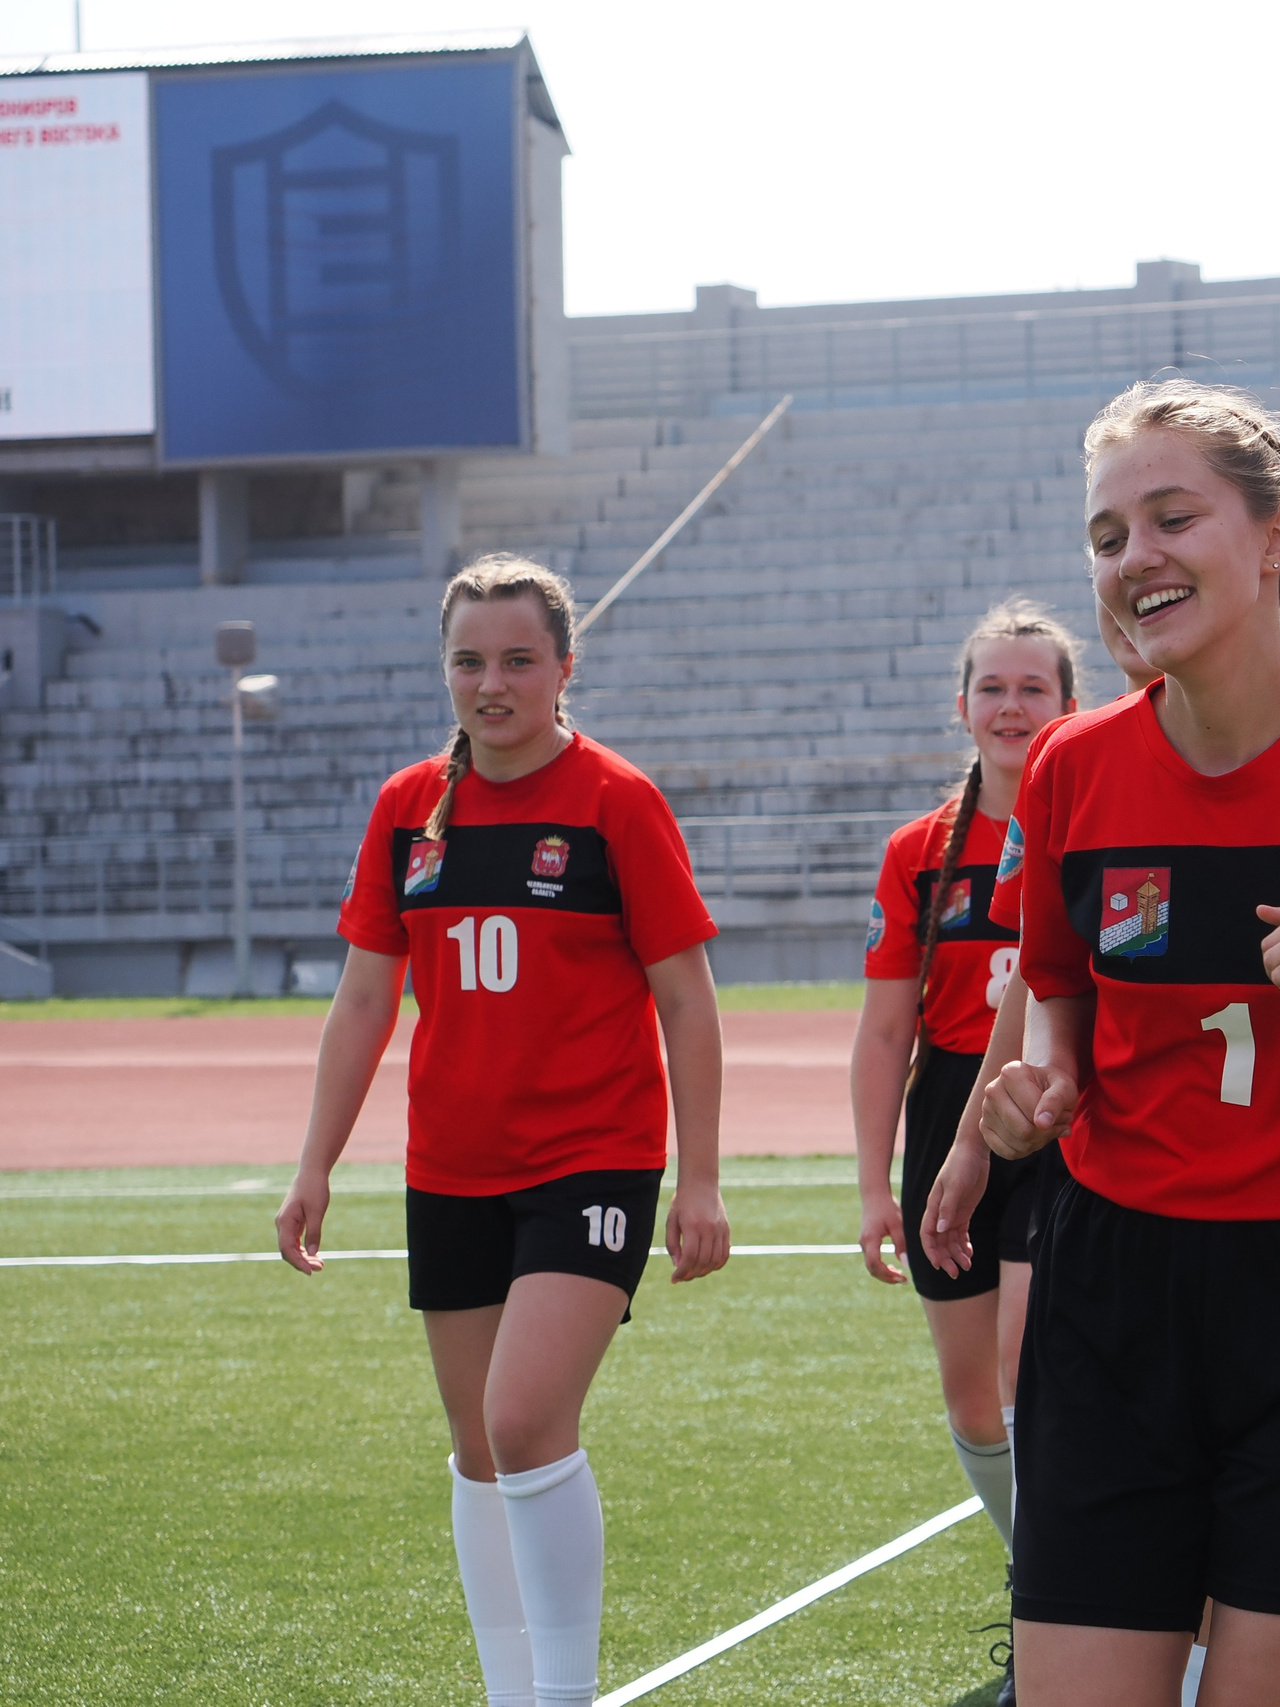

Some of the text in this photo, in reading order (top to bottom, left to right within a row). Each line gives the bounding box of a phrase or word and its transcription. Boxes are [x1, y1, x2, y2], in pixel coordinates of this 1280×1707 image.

[41, 123, 120, 145] ВОСТОКА
[447, 915, 518, 993] 10
[986, 946, 1020, 1010] 8
[1200, 1003, 1256, 1107] 1
[582, 1205, 627, 1252] 10
